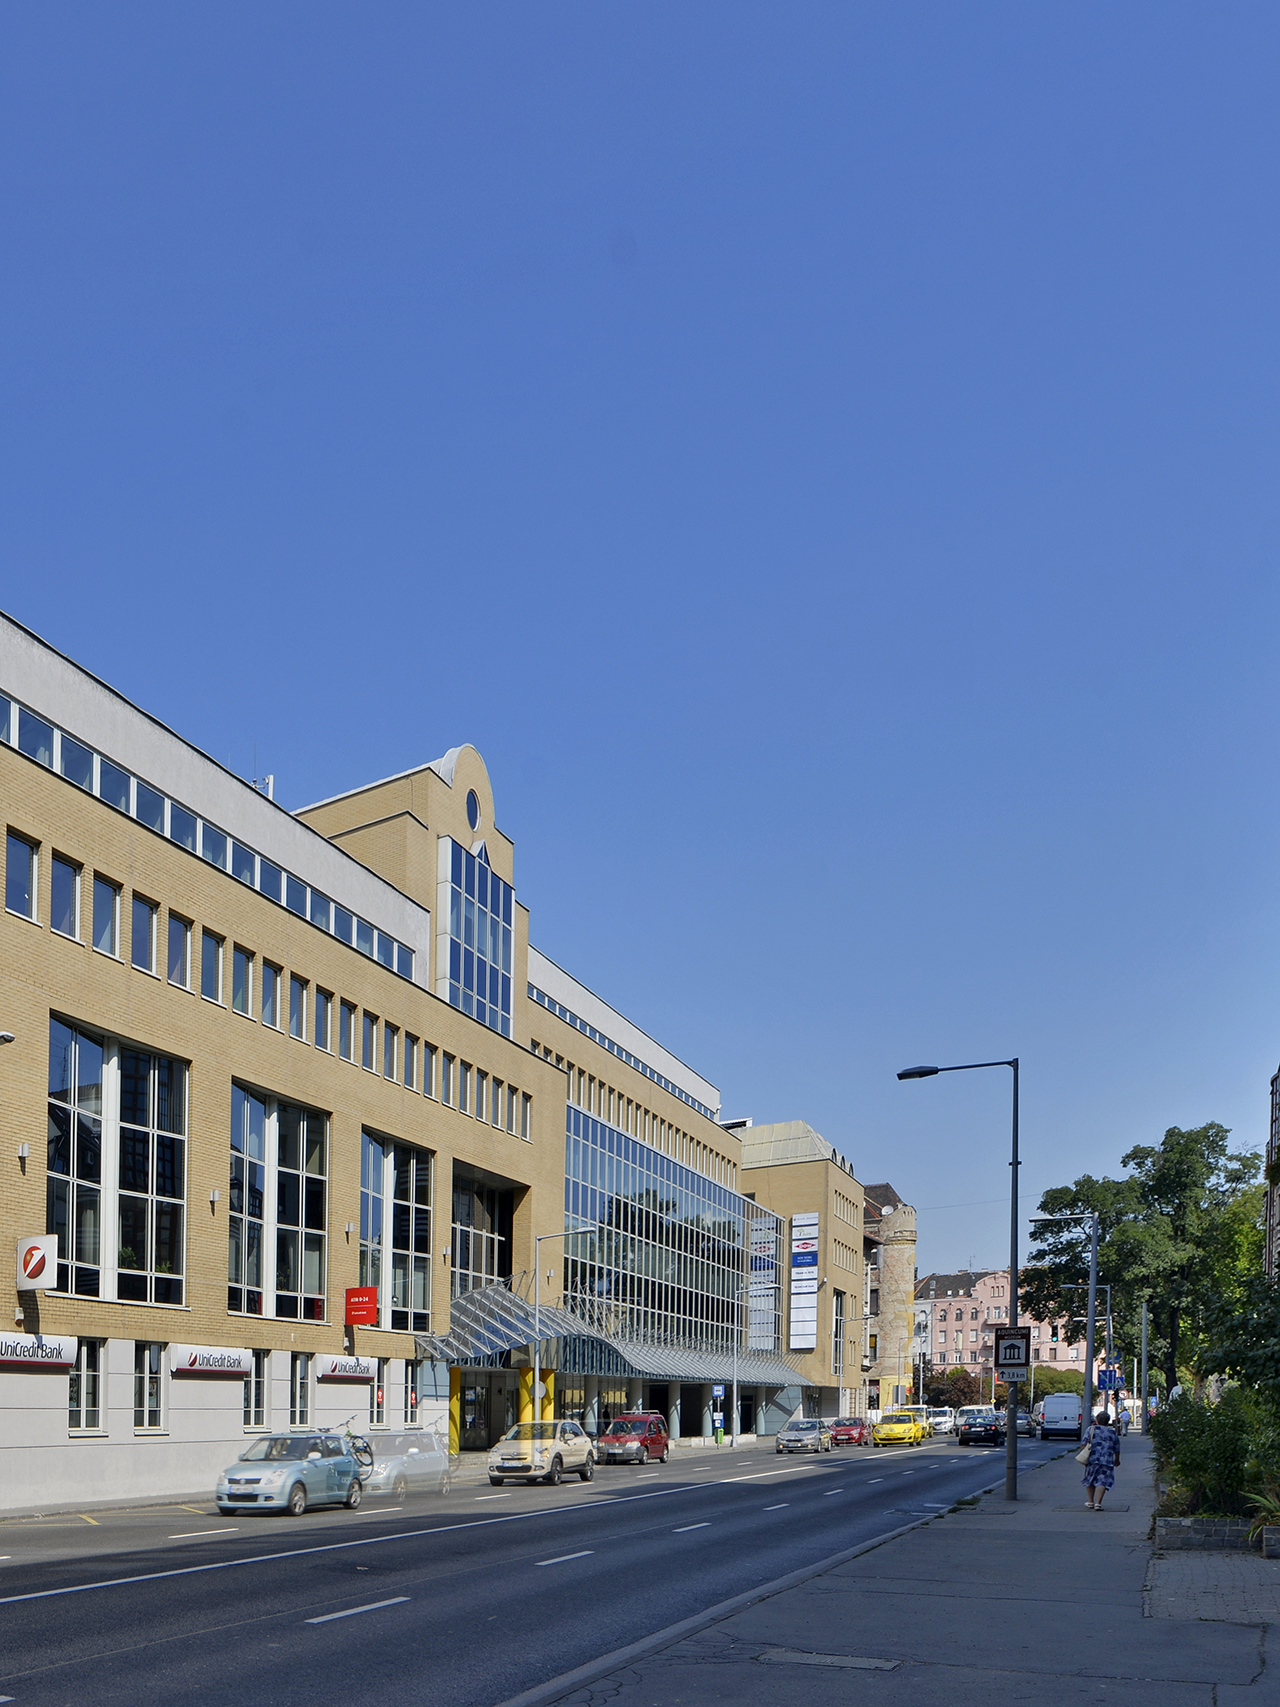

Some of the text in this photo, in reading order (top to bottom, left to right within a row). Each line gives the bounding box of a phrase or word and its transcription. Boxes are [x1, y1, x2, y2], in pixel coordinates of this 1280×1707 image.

[0, 1341, 63, 1359] UniCredit Bank
[199, 1353, 242, 1368] UniCredit Bank
[338, 1361, 370, 1374] UniCredit Bank
